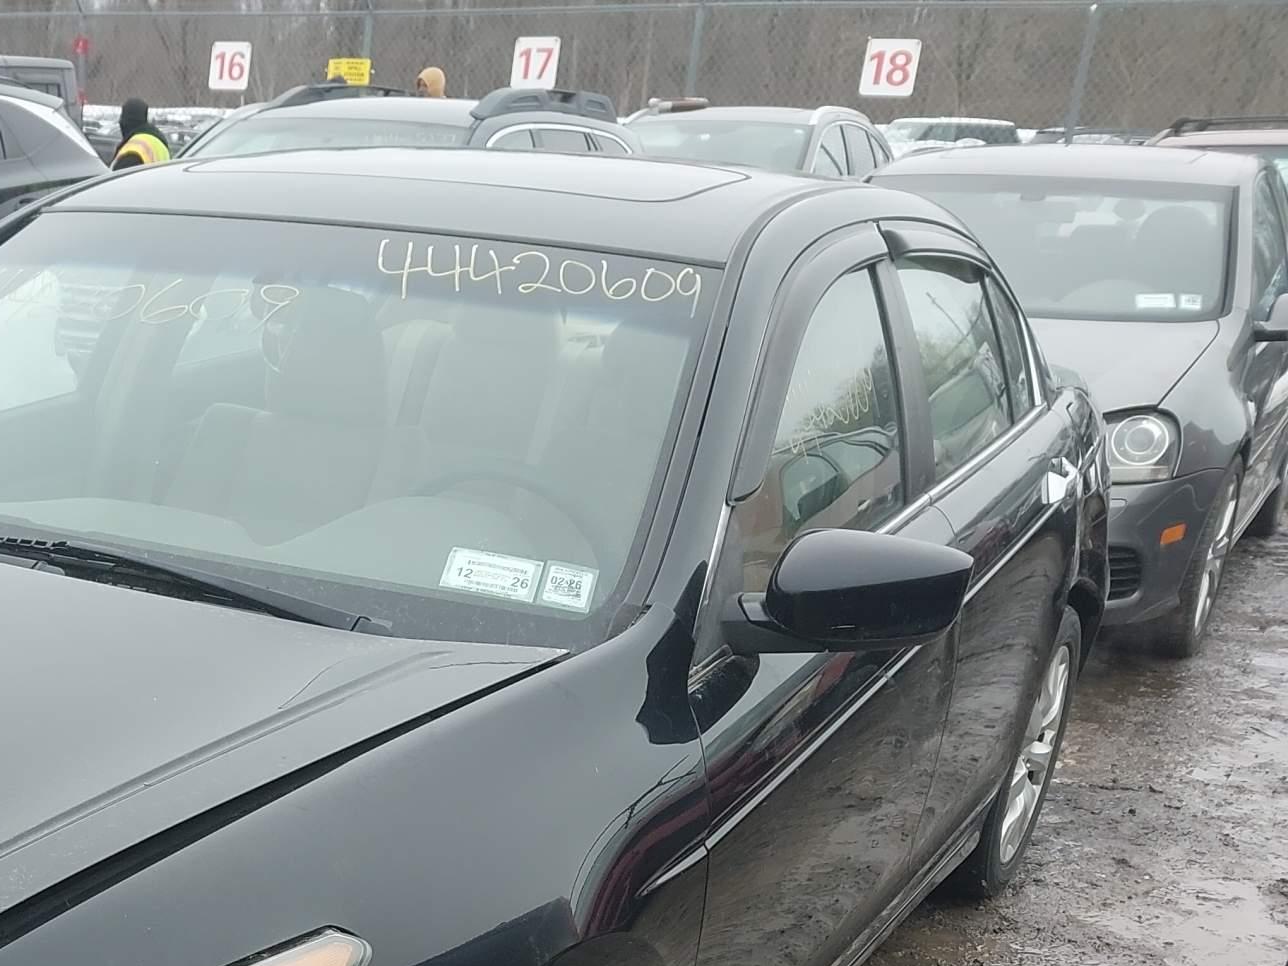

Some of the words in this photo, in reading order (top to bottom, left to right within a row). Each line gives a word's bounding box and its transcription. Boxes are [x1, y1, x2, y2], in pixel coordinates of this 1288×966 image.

[215, 51, 245, 81] 16
[519, 47, 554, 80] 17
[870, 49, 914, 87] 18
[378, 239, 702, 319] 44420609
[456, 566, 474, 580] 12
[510, 576, 530, 590] 26
